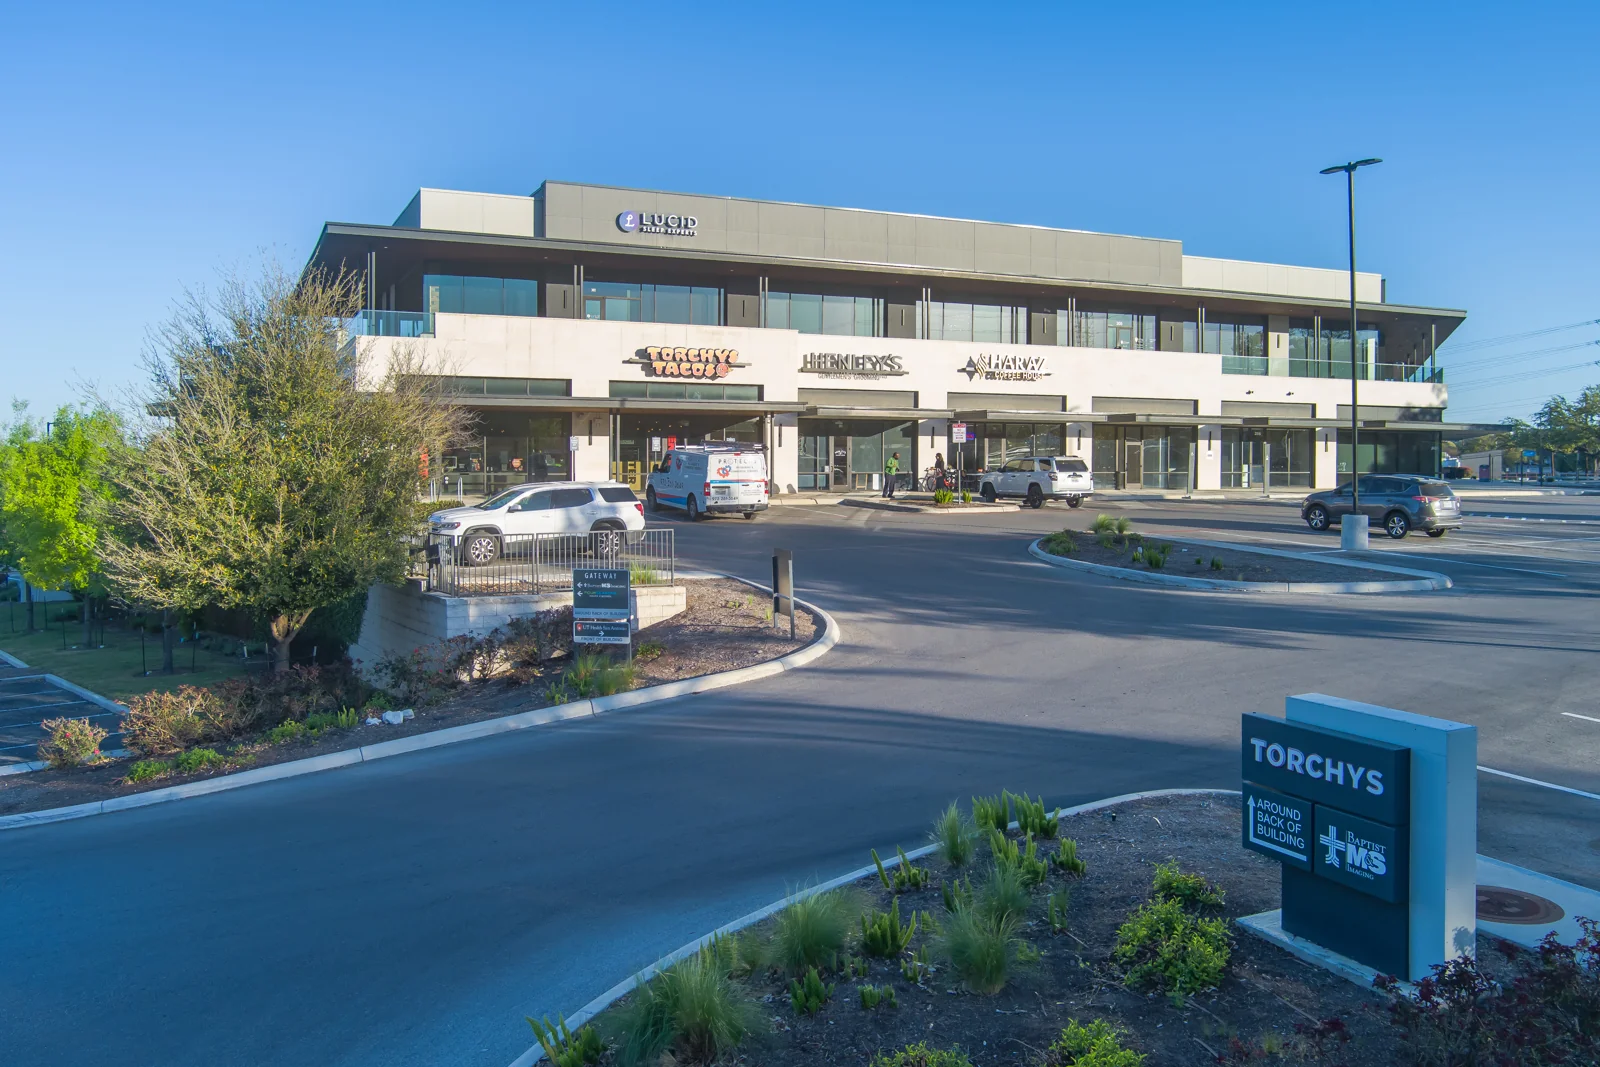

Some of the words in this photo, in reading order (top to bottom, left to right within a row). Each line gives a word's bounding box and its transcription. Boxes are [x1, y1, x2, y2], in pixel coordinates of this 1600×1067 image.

[642, 212, 698, 228] LUCID
[667, 228, 698, 236] EXPERTS
[646, 346, 739, 363] TORCHYS
[652, 361, 715, 377] TACOS
[995, 371, 1021, 379] COFFEE
[1250, 737, 1384, 795] TORCHYS
[1257, 798, 1301, 821] AROUND
[1257, 810, 1284, 830] BACK
[1287, 821, 1302, 834] OF
[1257, 823, 1305, 849] BUILDING
[1347, 843, 1387, 875] M&S
[1347, 863, 1375, 880] IMAGING
